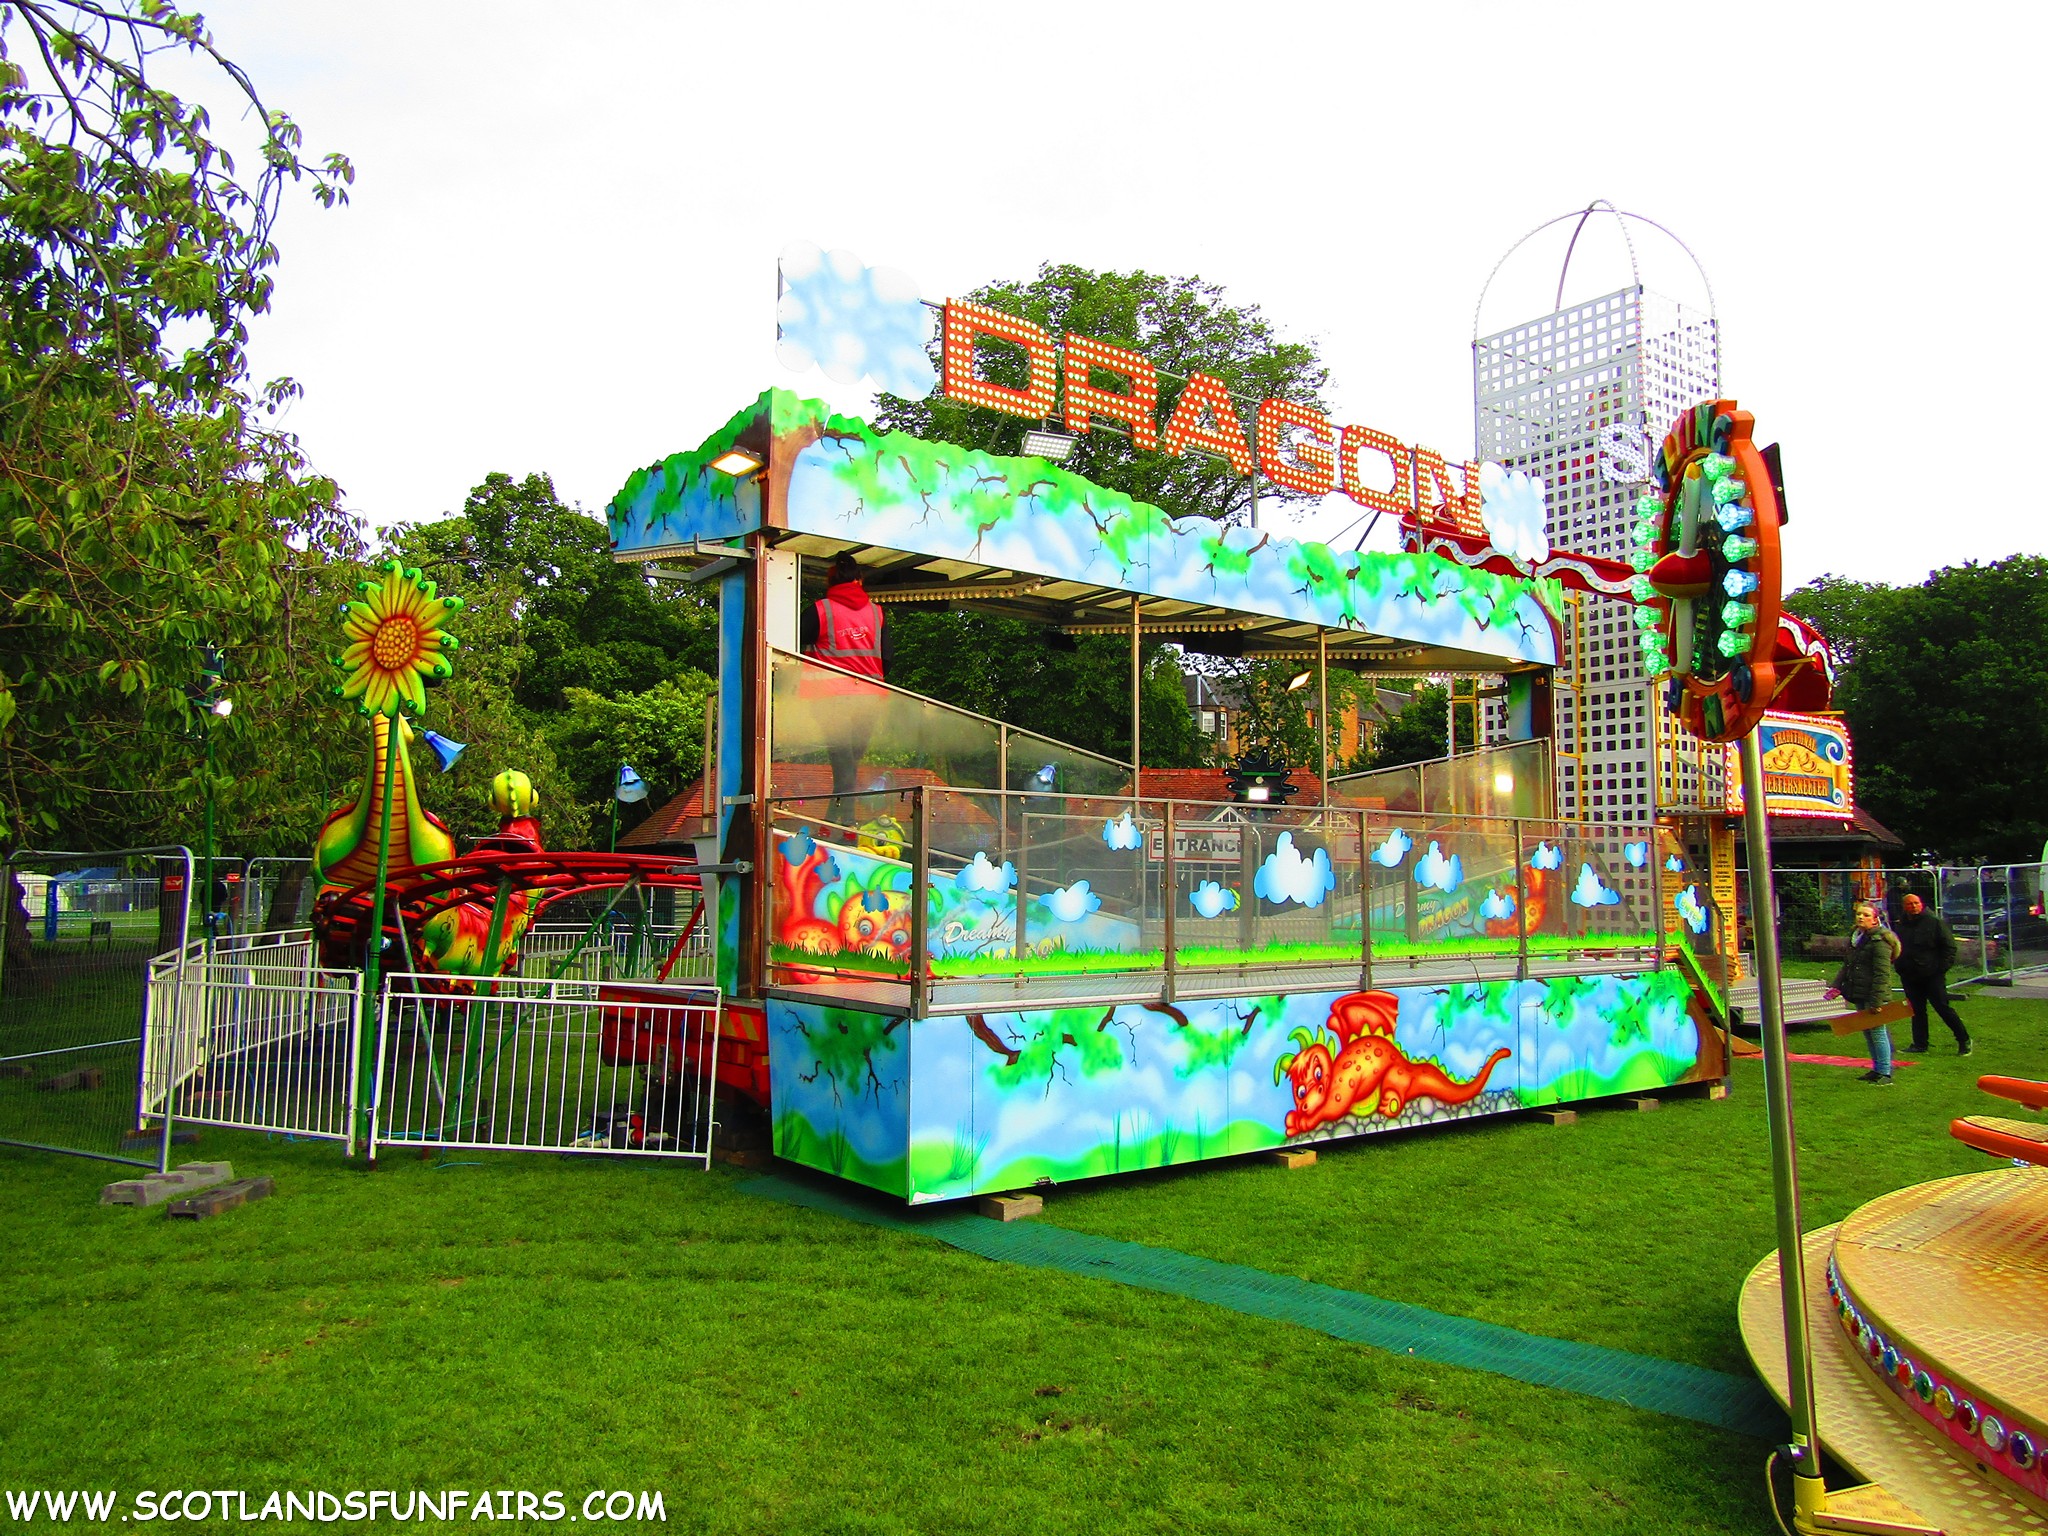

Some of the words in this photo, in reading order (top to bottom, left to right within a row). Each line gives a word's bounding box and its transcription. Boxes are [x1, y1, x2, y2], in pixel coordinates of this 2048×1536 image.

[945, 297, 1485, 537] DRAGON
[1772, 729, 1817, 753] TRADITIONAL
[1153, 837, 1241, 853] ETRANC
[1418, 896, 1469, 938] DRAGON
[945, 921, 1012, 946] Dreamy
